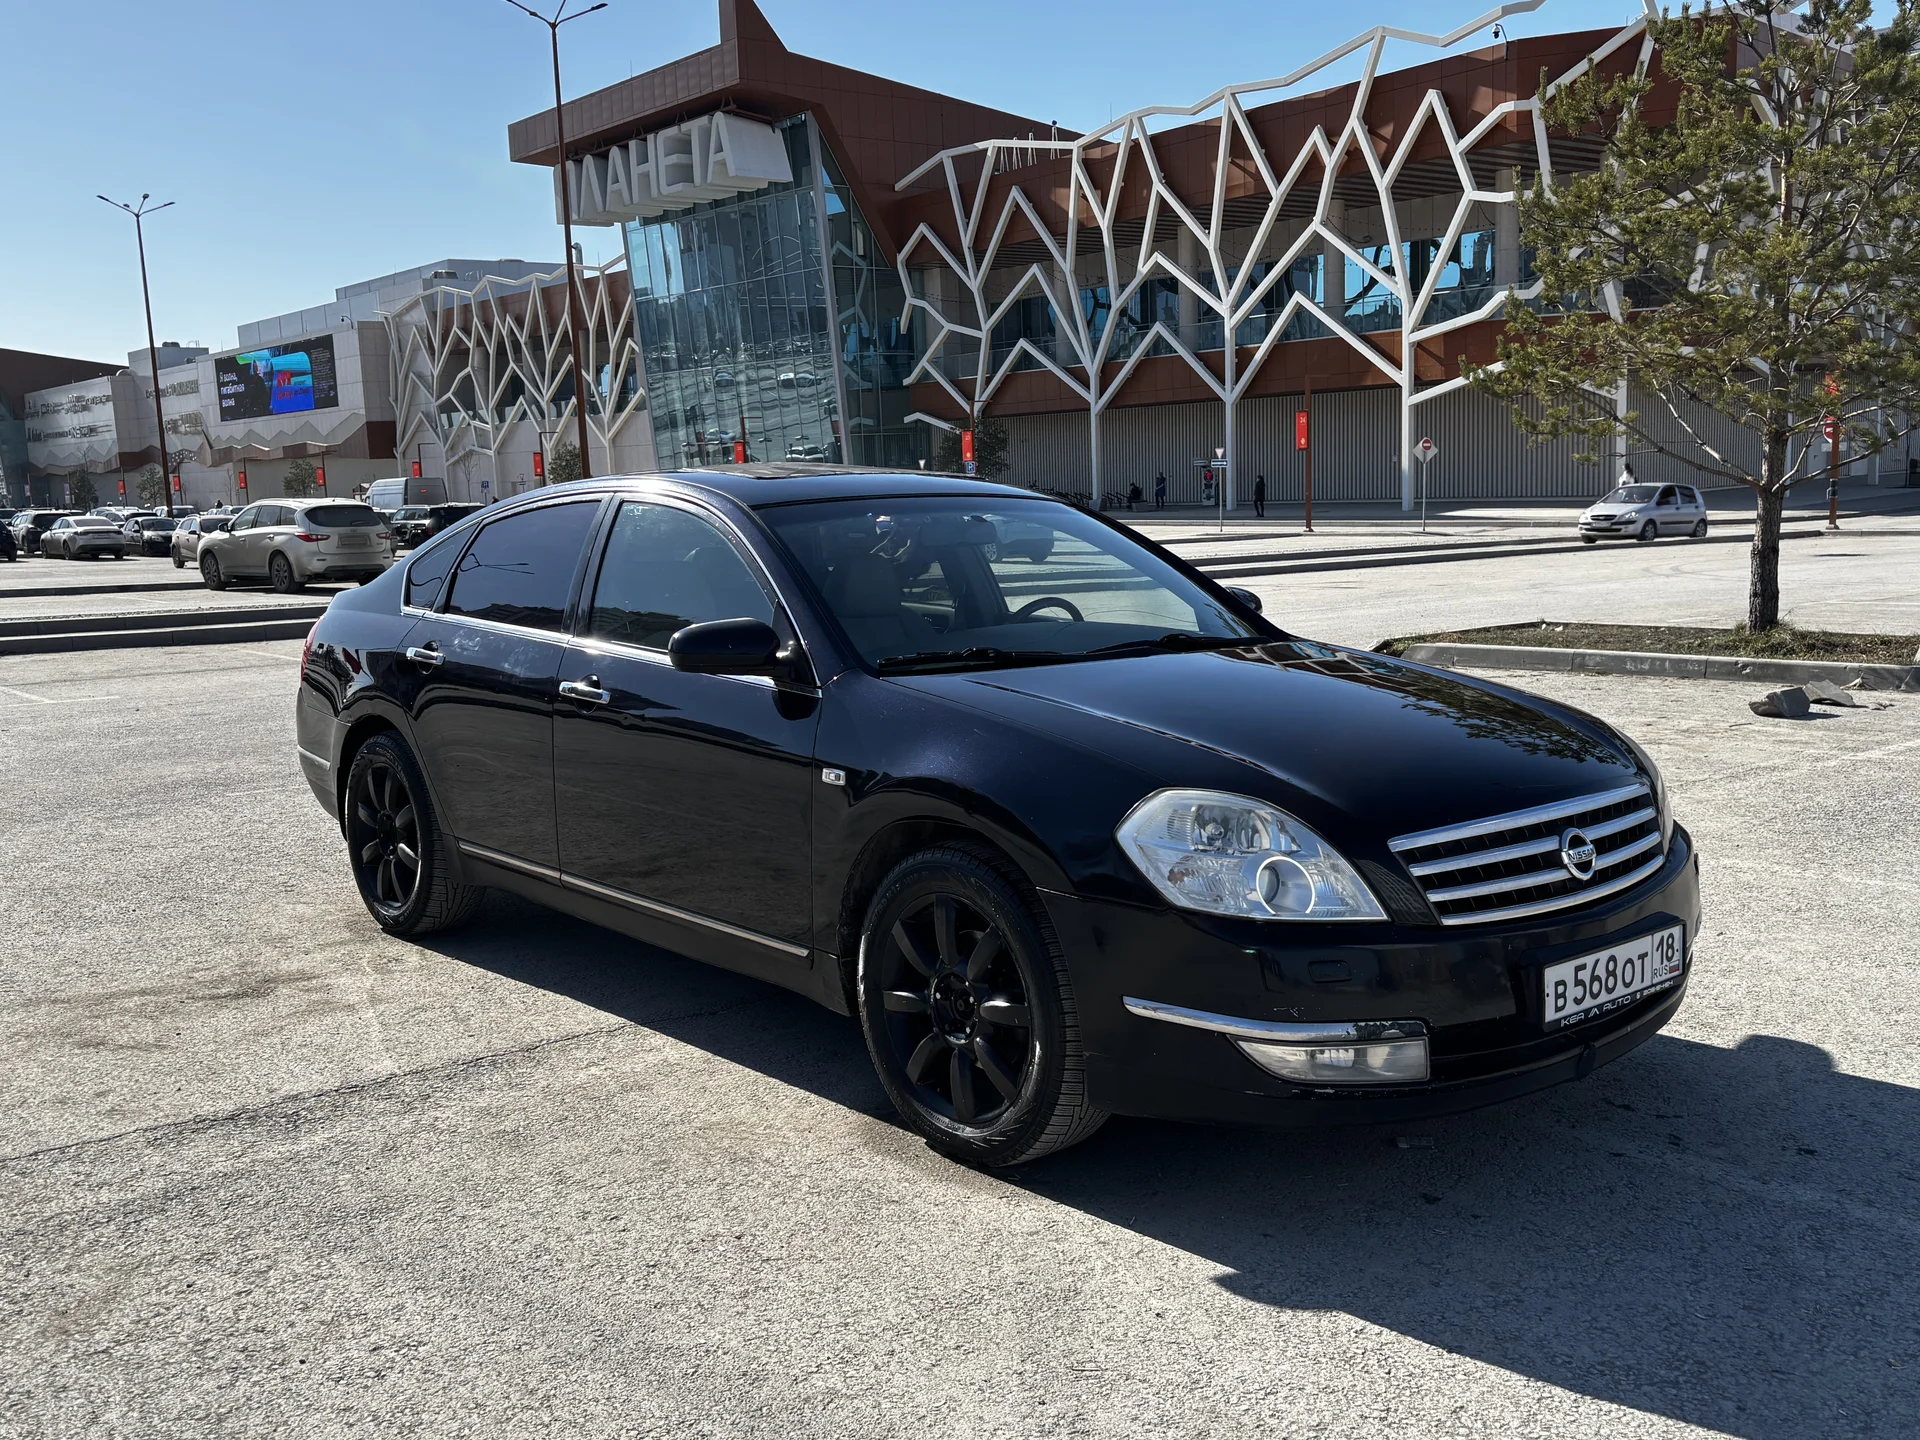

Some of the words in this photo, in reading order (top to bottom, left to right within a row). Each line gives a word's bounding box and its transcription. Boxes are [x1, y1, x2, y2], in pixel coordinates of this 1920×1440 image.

[1655, 932, 1675, 966] 18
[1653, 964, 1668, 979] RUS
[1602, 995, 1631, 1012] AUTO
